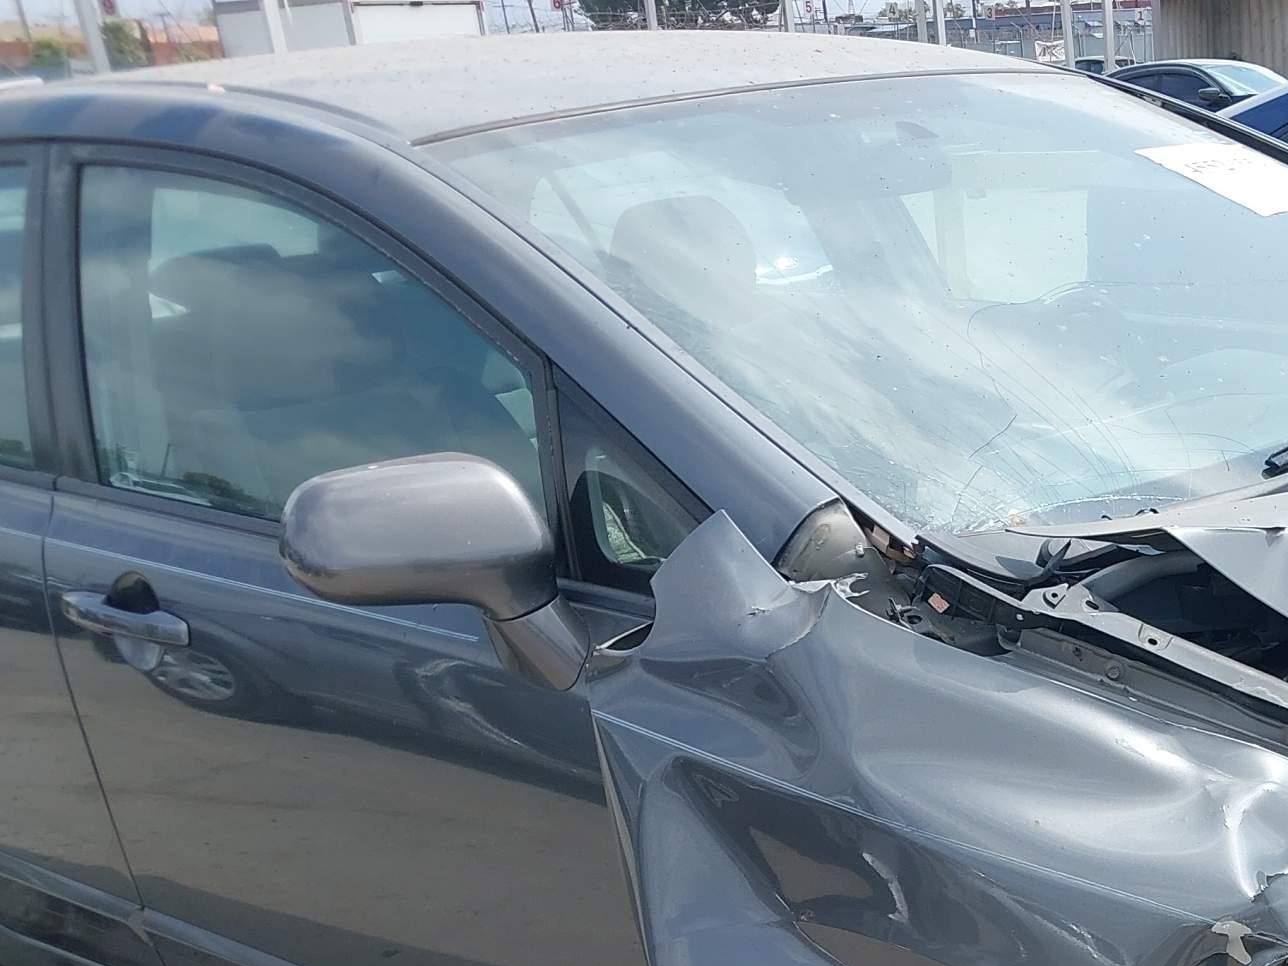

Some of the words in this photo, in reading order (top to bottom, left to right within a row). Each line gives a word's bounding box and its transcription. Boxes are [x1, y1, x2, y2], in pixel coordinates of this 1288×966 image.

[805, 1, 812, 13] 5
[889, 3, 896, 16] 4
[986, 8, 993, 18] 3
[1137, 11, 1144, 21] 1
